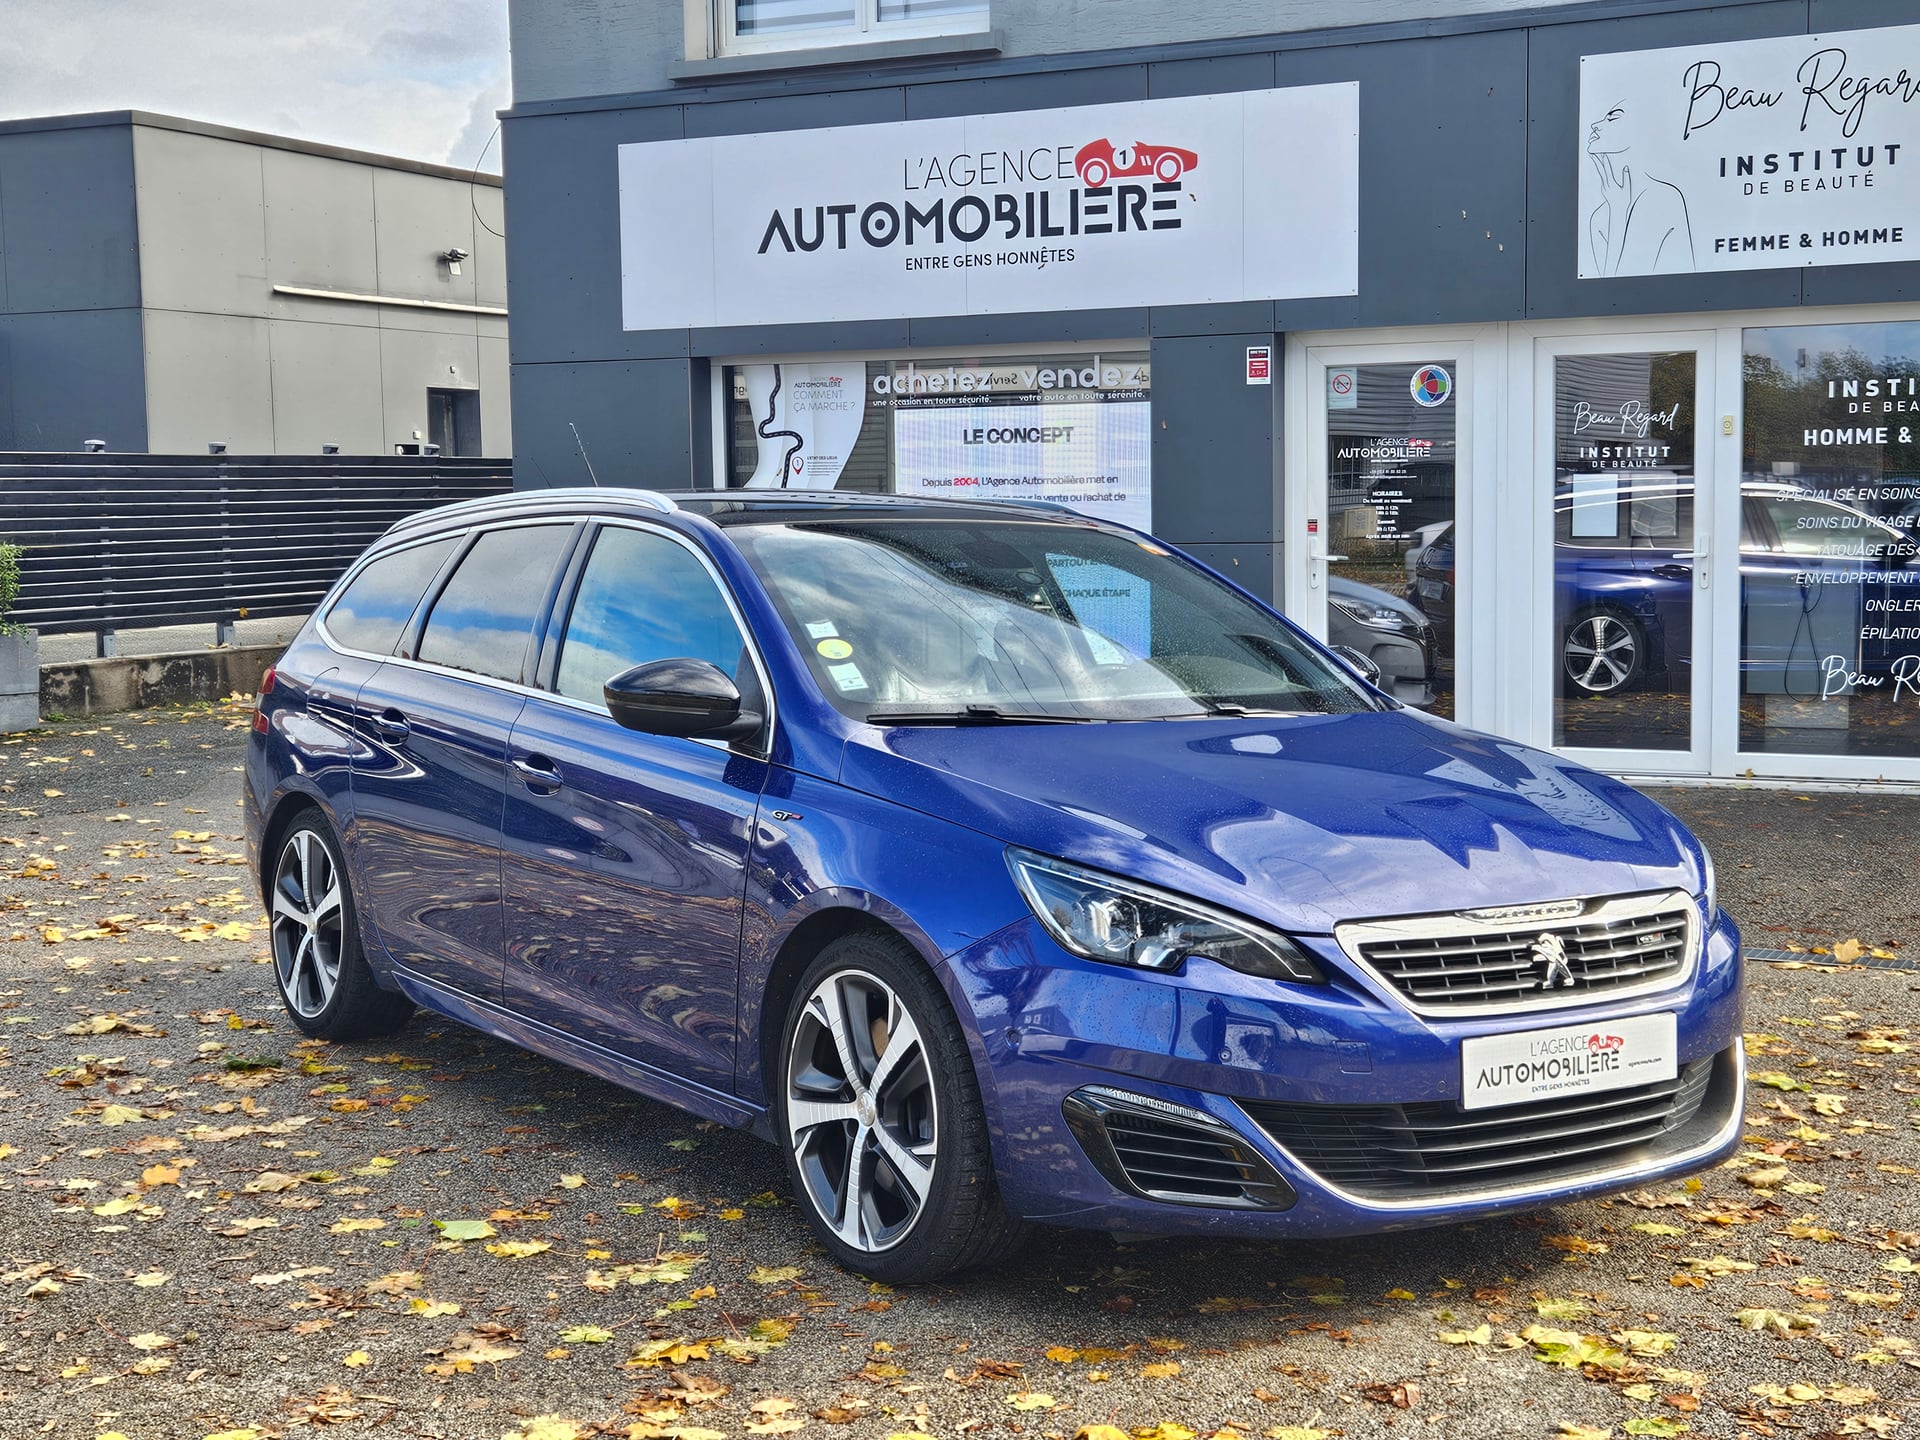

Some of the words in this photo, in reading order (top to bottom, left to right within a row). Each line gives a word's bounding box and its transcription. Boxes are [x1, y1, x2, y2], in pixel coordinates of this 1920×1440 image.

[1682, 60, 1784, 141] Beau
[1796, 48, 1920, 138] Regar
[1118, 149, 1127, 165] 1
[1719, 144, 1901, 178] INSTITUT
[903, 145, 1075, 191] L'AGENCE
[1743, 181, 1769, 196] DE
[1784, 170, 1874, 194] BEAUTÉ
[1714, 234, 1790, 254] FEMME
[1799, 233, 1813, 248] &
[1822, 227, 1904, 247] HOMME
[905, 256, 949, 271] ENTRE
[953, 253, 992, 268] GENS
[996, 246, 1075, 266] HONNÊTES
[873, 362, 993, 395] achetez
[1019, 355, 1141, 390] vendez
[793, 390, 844, 400] COMMENT
[1019, 394, 1041, 402] votre
[1044, 393, 1065, 401] auto
[1081, 392, 1104, 400] toute
[1107, 389, 1146, 399] sérénité.
[1828, 378, 1915, 399] INSTI
[793, 402, 806, 413] ÇA
[807, 401, 848, 411] MARCHE
[851, 401, 856, 410] ?
[872, 399, 887, 407] une
[889, 394, 921, 406] occasion
[935, 396, 956, 404] toute
[959, 394, 992, 404] sécurité.
[1848, 402, 1871, 414] DE
[1573, 401, 1615, 435] Beau
[1620, 400, 1680, 438] Regard
[963, 428, 984, 445] LE
[986, 426, 1074, 444] CONCEPT
[1370, 438, 1408, 447] L'AGENCE
[1804, 427, 1889, 446] HOMME
[1898, 426, 1913, 444] &
[1580, 446, 1671, 458] INSTITUT
[1612, 458, 1657, 468] BEAUTÉ
[922, 478, 952, 488] Depuis
[953, 477, 980, 487] 2004,
[982, 477, 1020, 488] L'Agence
[1021, 475, 1085, 486] Automobilière
[1086, 476, 1105, 484] met
[1107, 476, 1118, 484] en
[1070, 494, 1082, 502] ou
[1114, 492, 1126, 501] de
[1858, 488, 1878, 500] EN
[1796, 517, 1839, 529] SOINS
[1841, 518, 1862, 528] DU
[1864, 515, 1914, 528] VISAGE
[1816, 543, 1885, 557] TATOUAGE
[1886, 543, 1917, 556] DES
[1796, 571, 1917, 584] ENVELOPPEMENT
[1821, 655, 1884, 701] Beau
[772, 809, 793, 821] GT
[1530, 1034, 1589, 1057] L'AGENCE
[1531, 1084, 1548, 1093] ENTRE
